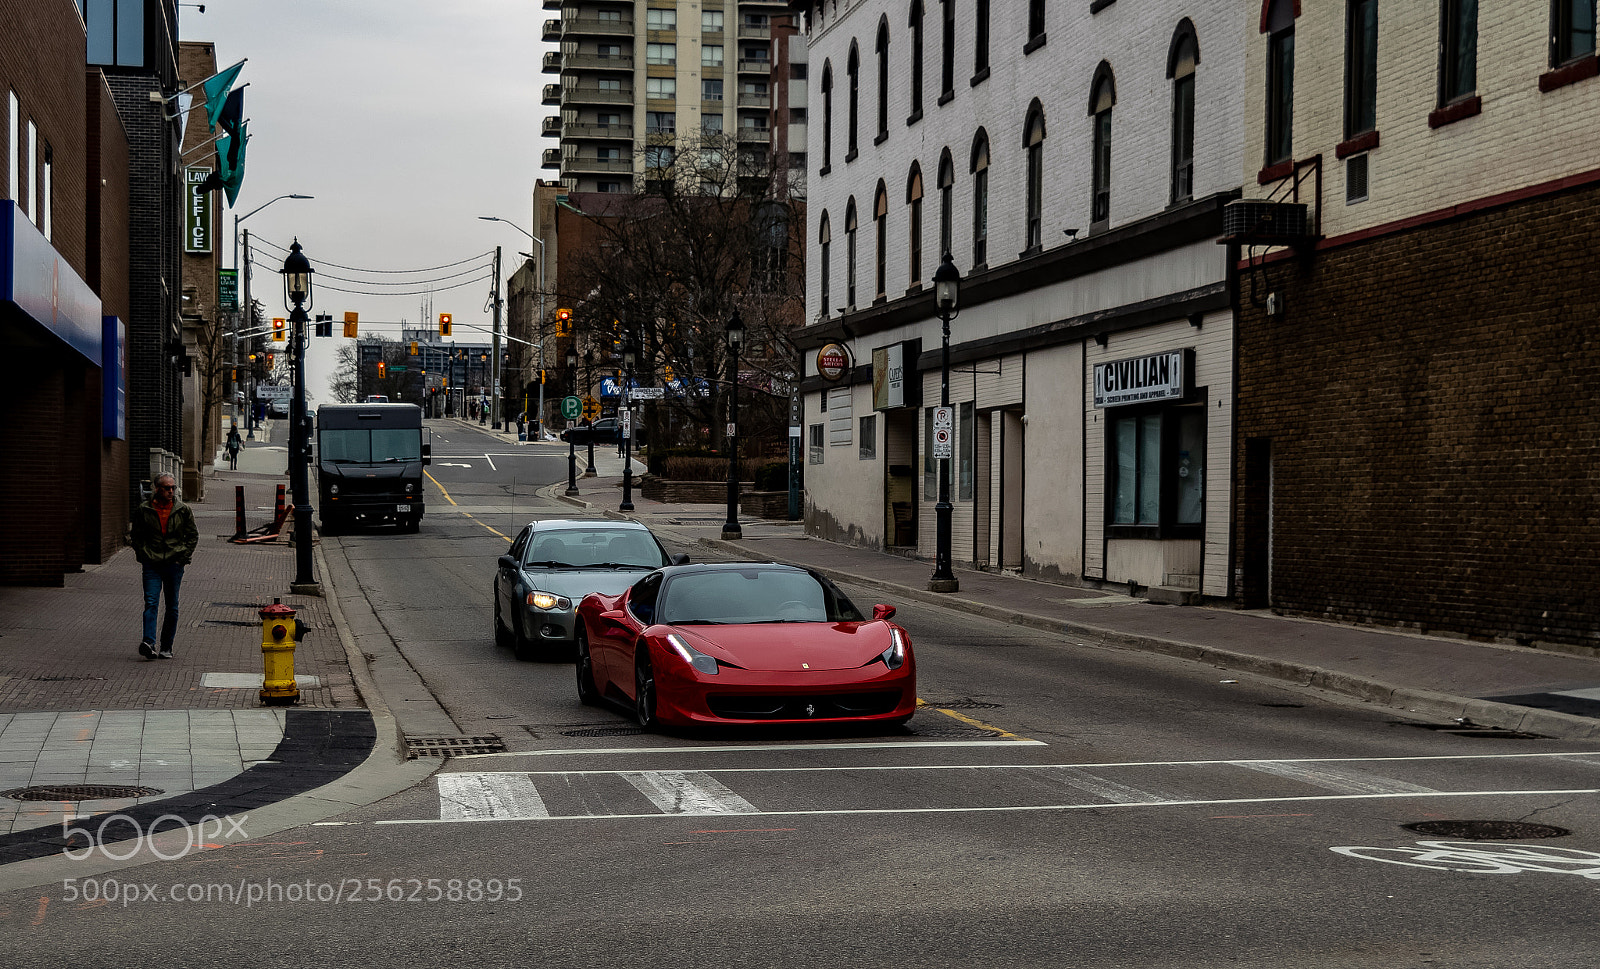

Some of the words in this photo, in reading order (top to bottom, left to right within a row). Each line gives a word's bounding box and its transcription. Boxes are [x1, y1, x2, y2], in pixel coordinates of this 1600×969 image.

[188, 172, 208, 182] LAW
[1103, 354, 1170, 392] CIVILIAN
[1121, 393, 1139, 402] PRINTING
[1139, 392, 1148, 400] AND
[1148, 389, 1166, 398] APPAREL
